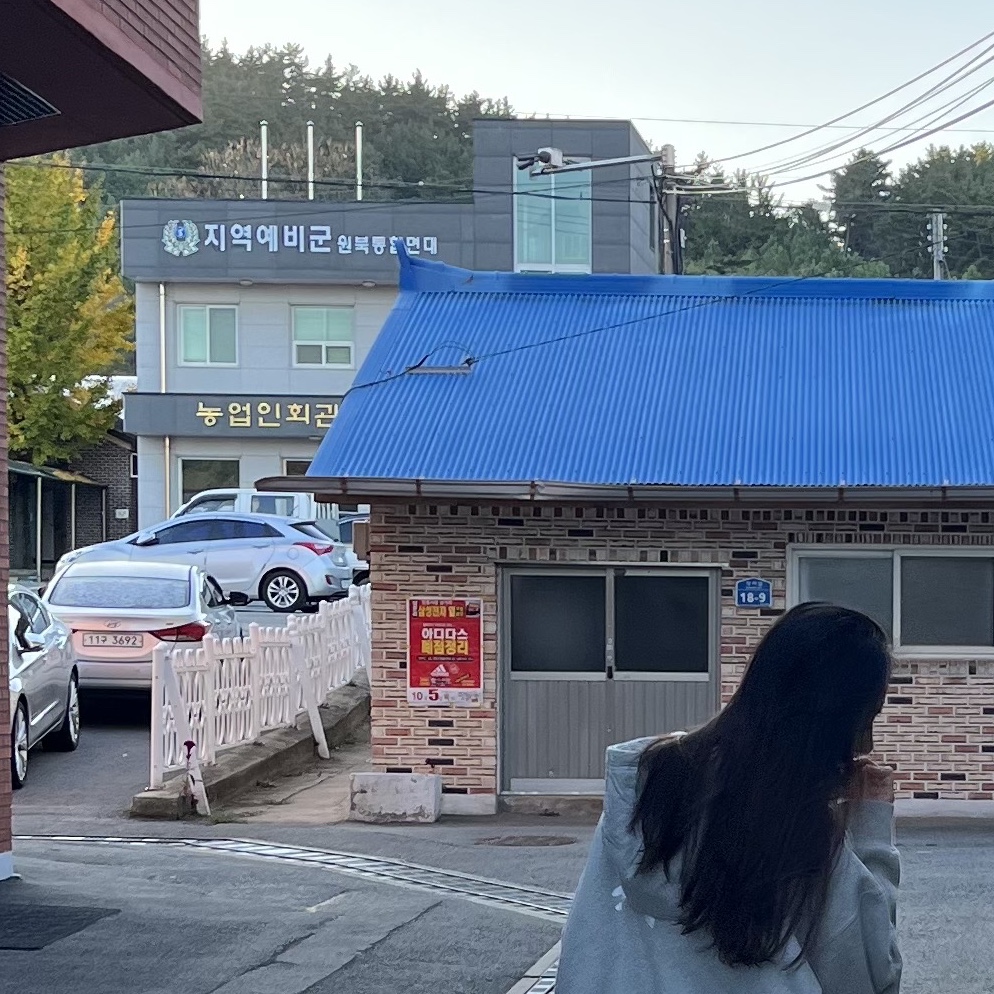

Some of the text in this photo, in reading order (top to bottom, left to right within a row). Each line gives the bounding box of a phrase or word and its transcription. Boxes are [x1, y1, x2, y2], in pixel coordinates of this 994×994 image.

[204, 223, 332, 253] 지역예비군
[196, 402, 339, 428] 농업인회관
[740, 592, 766, 603] 18-9
[421, 627, 469, 640] 아디다스
[112, 635, 137, 646] 3692
